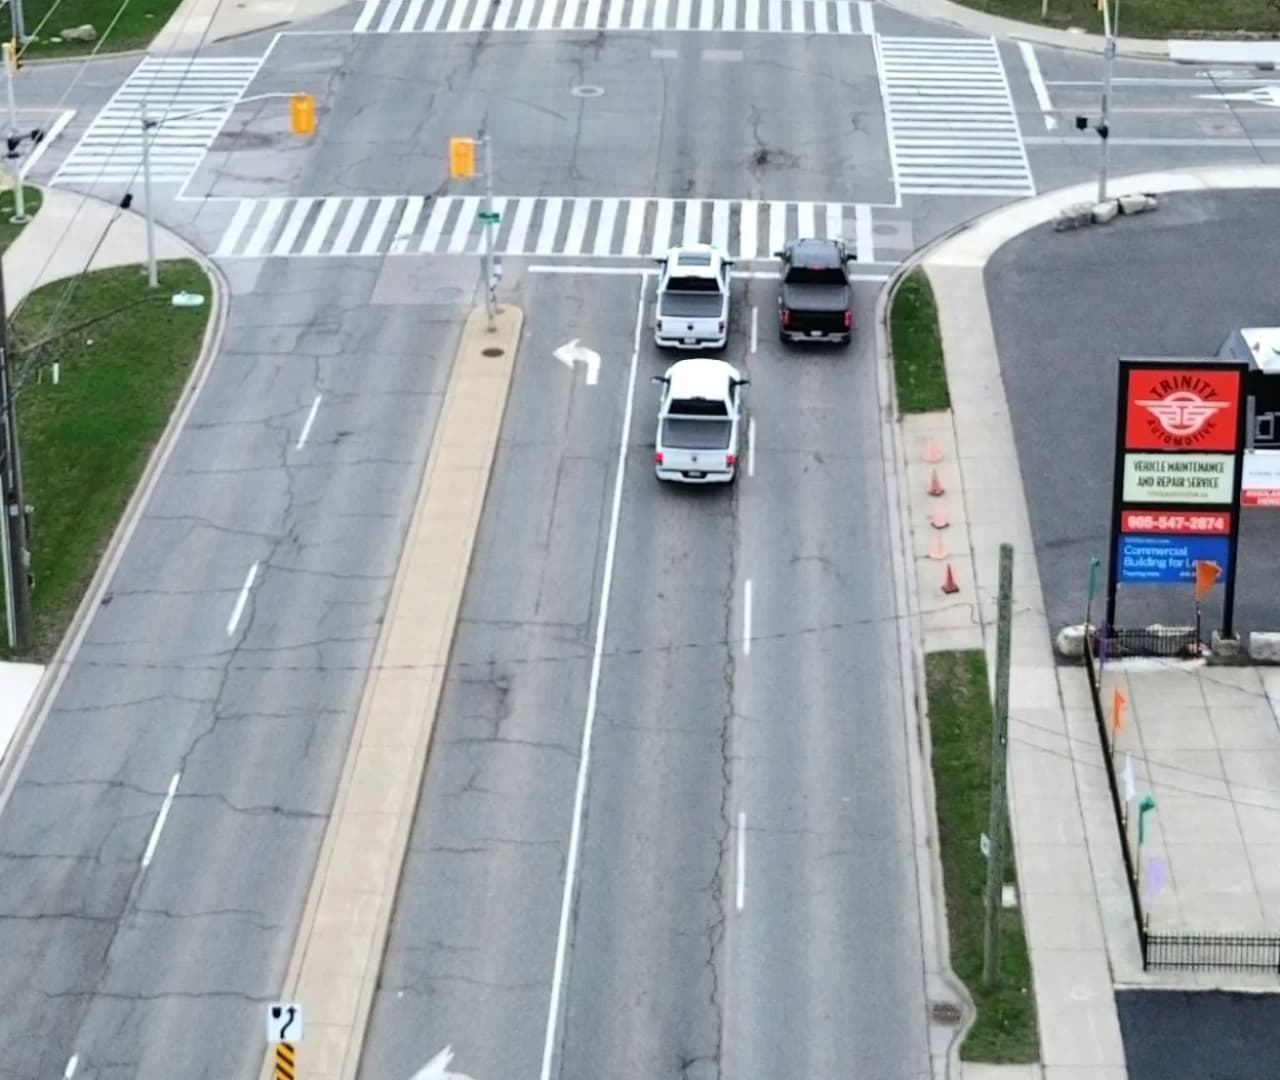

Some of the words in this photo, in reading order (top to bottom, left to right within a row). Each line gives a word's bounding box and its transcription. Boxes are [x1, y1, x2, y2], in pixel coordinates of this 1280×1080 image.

[1149, 376, 1219, 400] TRINITY
[1147, 419, 1217, 446] AUTOMOTIVE
[1134, 460, 1165, 472] VEHICLE
[1167, 461, 1225, 474] MAINTENANCE
[1137, 476, 1154, 488] AND
[1156, 476, 1186, 488] REPAIR
[1187, 477, 1219, 489] SERVICE
[1123, 545, 1188, 557] Commercial
[1123, 556, 1167, 569] Building
[1168, 557, 1185, 568] for
